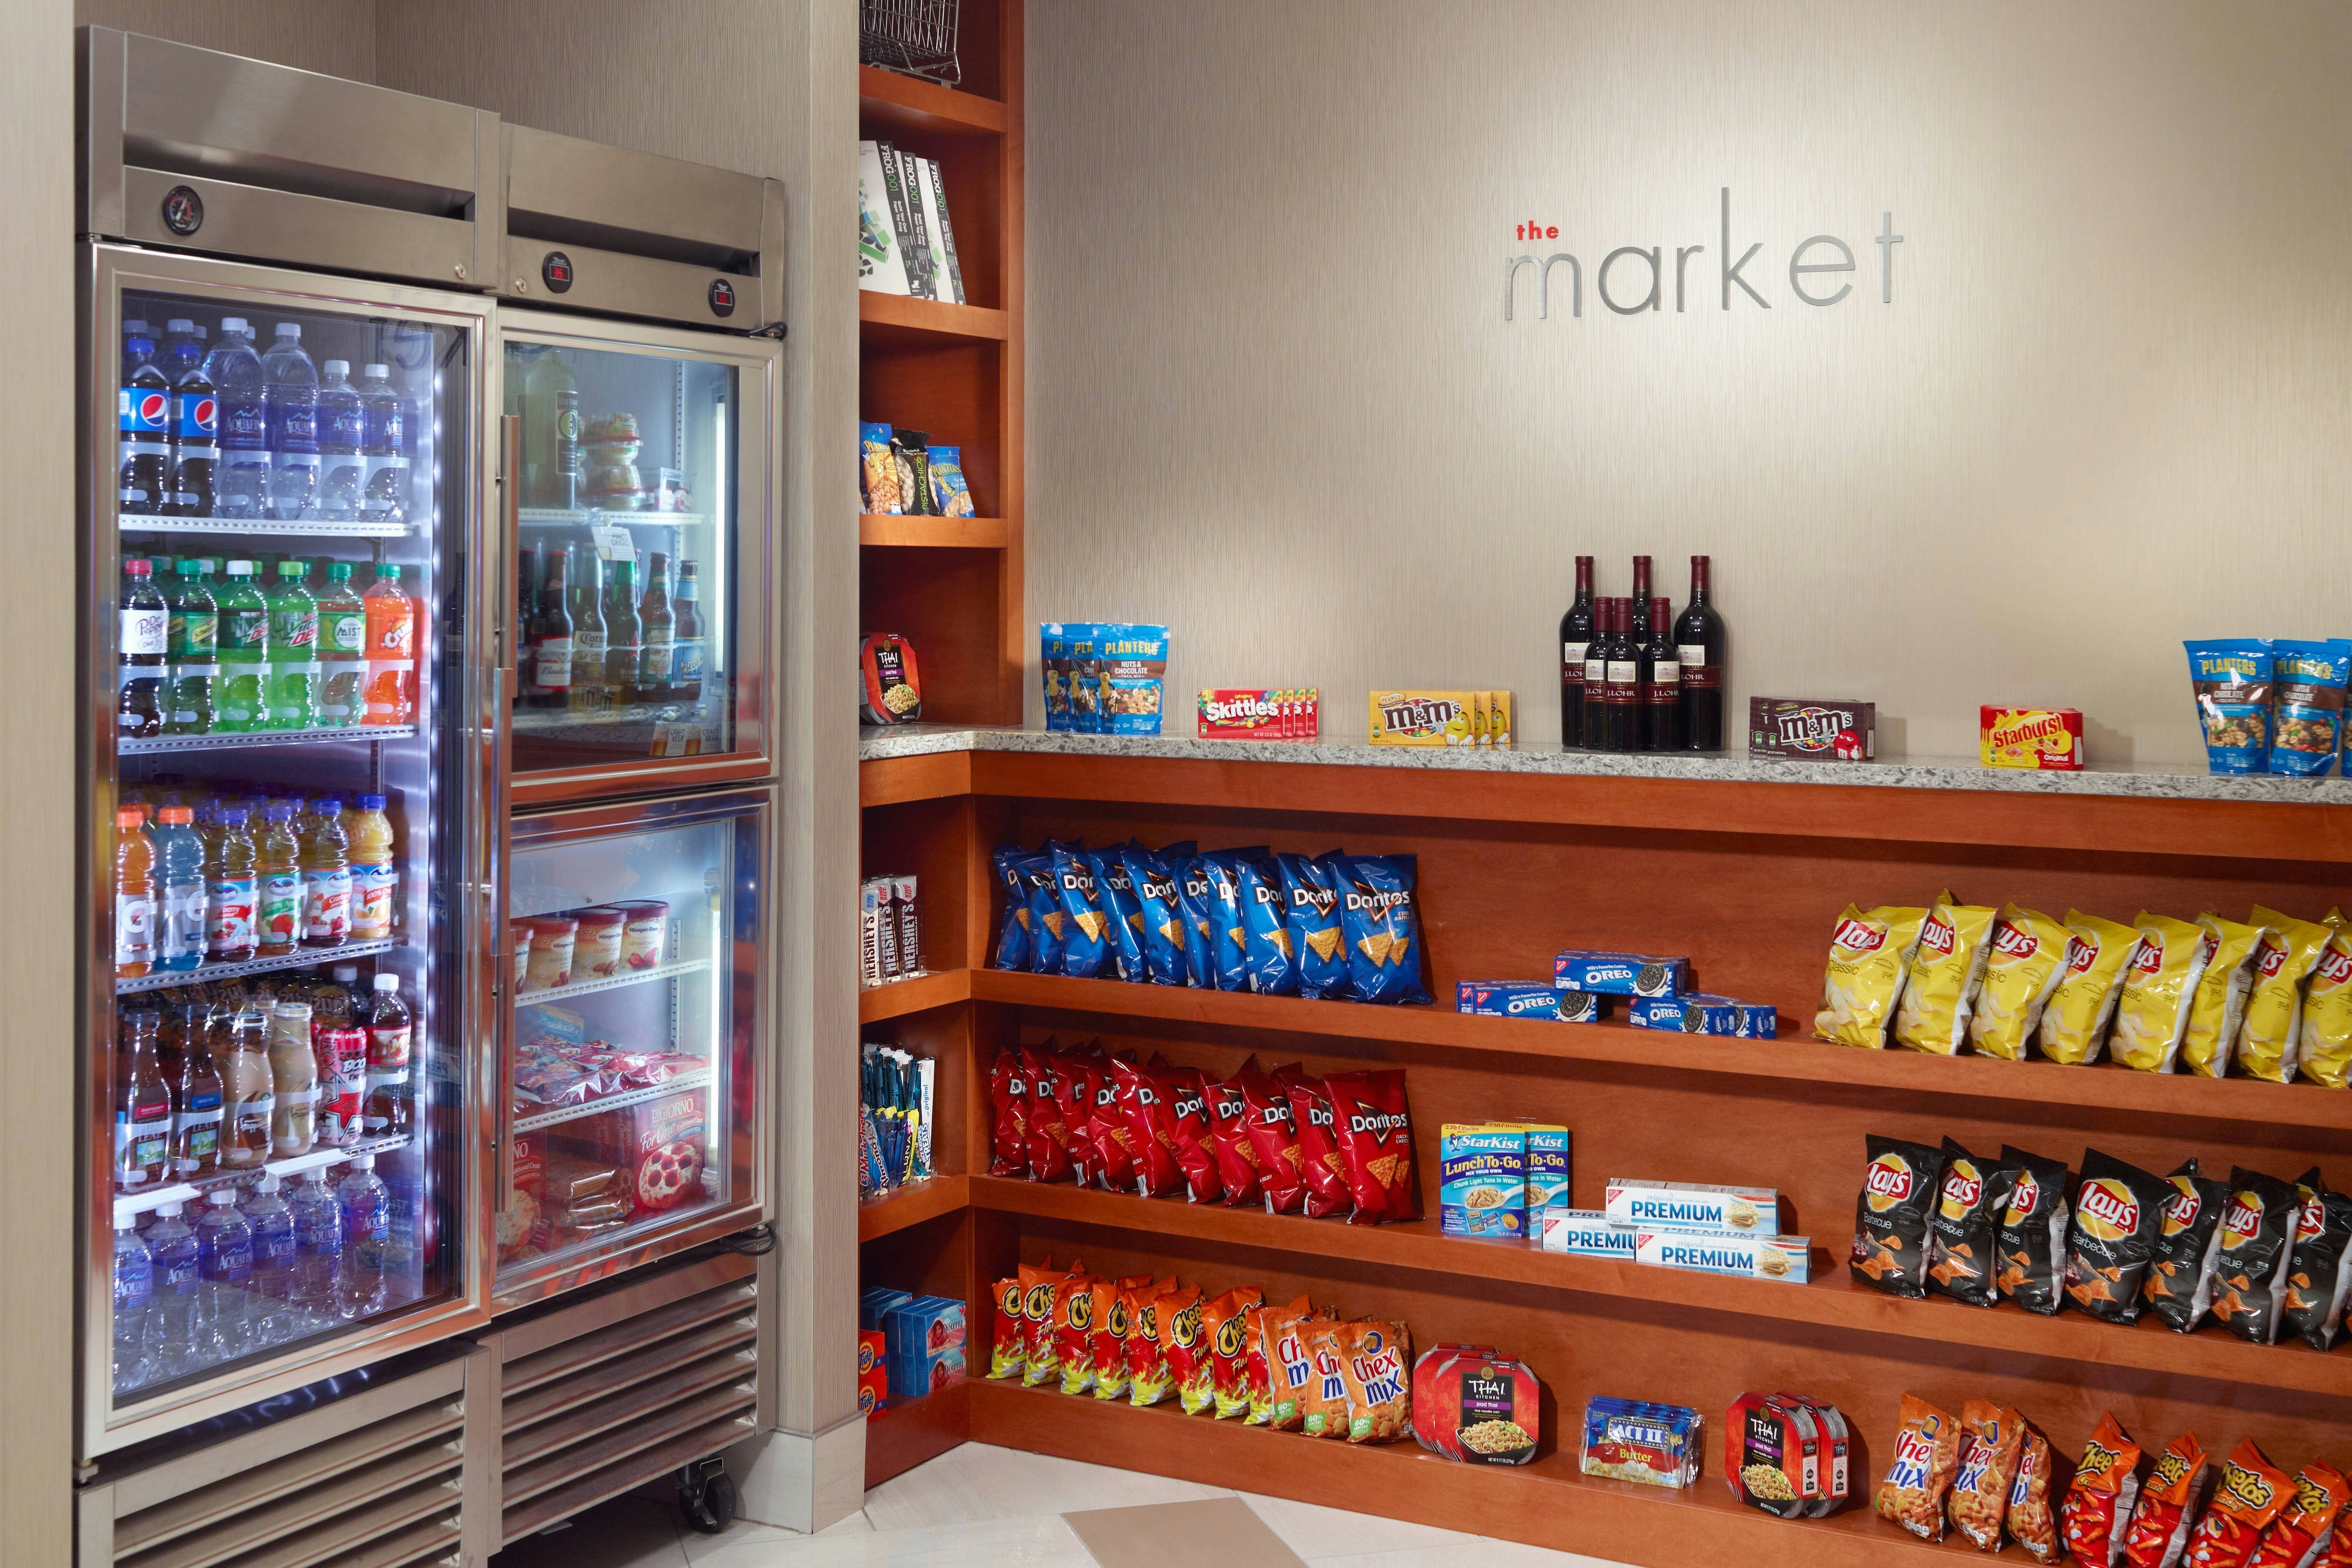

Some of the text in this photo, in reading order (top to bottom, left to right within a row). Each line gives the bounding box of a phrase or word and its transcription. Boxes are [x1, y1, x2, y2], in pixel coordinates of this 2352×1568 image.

[1517, 220, 1559, 240] the
[1505, 187, 1903, 320] market
[336, 627, 361, 636] MIST
[1105, 640, 1158, 656] PLANTERS
[878, 652, 898, 664] THAI
[2201, 657, 2256, 676] PLANTERS
[1381, 695, 1401, 703] PEANUT
[1206, 698, 1279, 721] Skittles
[1993, 715, 2062, 748] Starburst
[1347, 891, 1410, 910] Doritos
[1585, 969, 1632, 984] OREO
[1828, 959, 1860, 976] Classic
[1507, 997, 1555, 1014] OREO
[1650, 1008, 1681, 1021] OREO
[1351, 1113, 1407, 1132] Doritos
[922, 1123, 931, 1160] TREATS
[1461, 1135, 1521, 1150] StarKist
[903, 1134, 912, 1174] LUNA
[872, 1142, 888, 1188] Almond
[1444, 1156, 1521, 1176] Lunch To-Go
[1867, 1163, 1910, 1198] Lay's
[1646, 1193, 1673, 1202] original
[2079, 1181, 2137, 1229] Lay's
[1631, 1201, 1722, 1222] PREMIUM
[1863, 1212, 1892, 1229] Barbecue
[1677, 1239, 1704, 1248] original
[2072, 1231, 2117, 1261] Barbecue
[1662, 1246, 1753, 1269] PREMIUM
[943, 1319, 963, 1333] Downy
[945, 1360, 963, 1374] Downy
[1352, 1348, 1395, 1382] Chex
[1365, 1369, 1404, 1406] mix
[1468, 1380, 1505, 1395] THAI
[860, 1394, 874, 1410] Tide
[1617, 1424, 1662, 1443] ACT II
[1750, 1418, 1778, 1440] THAI
[1755, 1435, 1773, 1445] KITCHEN
[1620, 1449, 1652, 1462] Butter
